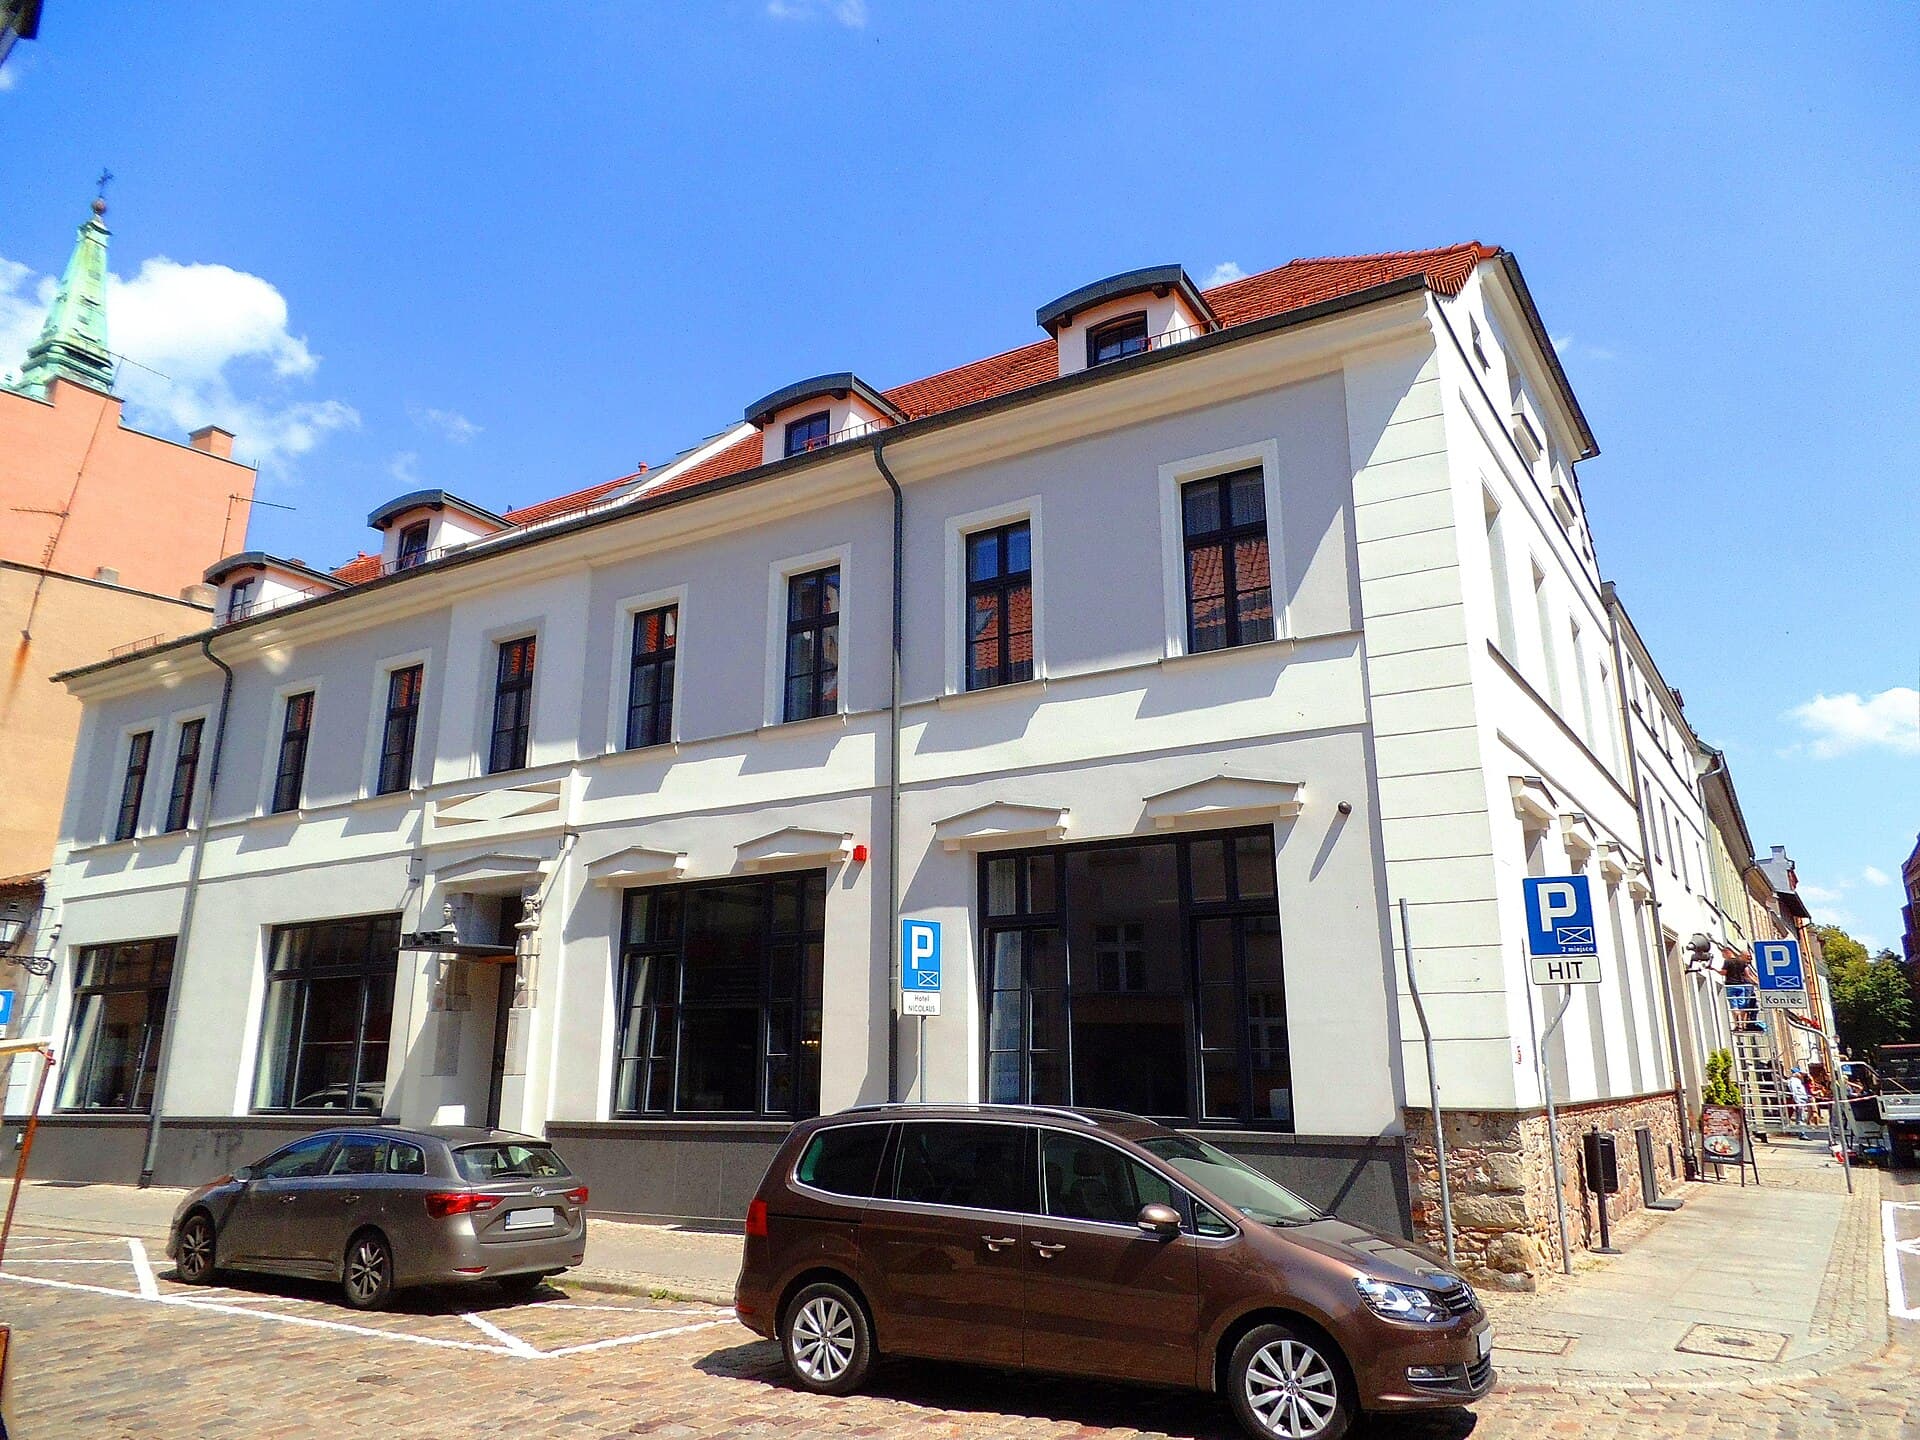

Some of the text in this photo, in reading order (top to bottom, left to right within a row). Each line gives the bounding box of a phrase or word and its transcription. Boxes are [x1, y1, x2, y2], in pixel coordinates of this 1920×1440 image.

[1537, 882, 1577, 932] P
[911, 925, 934, 970] P
[1561, 946, 1567, 954] 2
[1763, 944, 1791, 976] P
[1548, 961, 1583, 980] HIT
[914, 994, 930, 1003] Hotel
[1765, 995, 1803, 1005] Koniec
[908, 1004, 936, 1013] NICOLAUS
